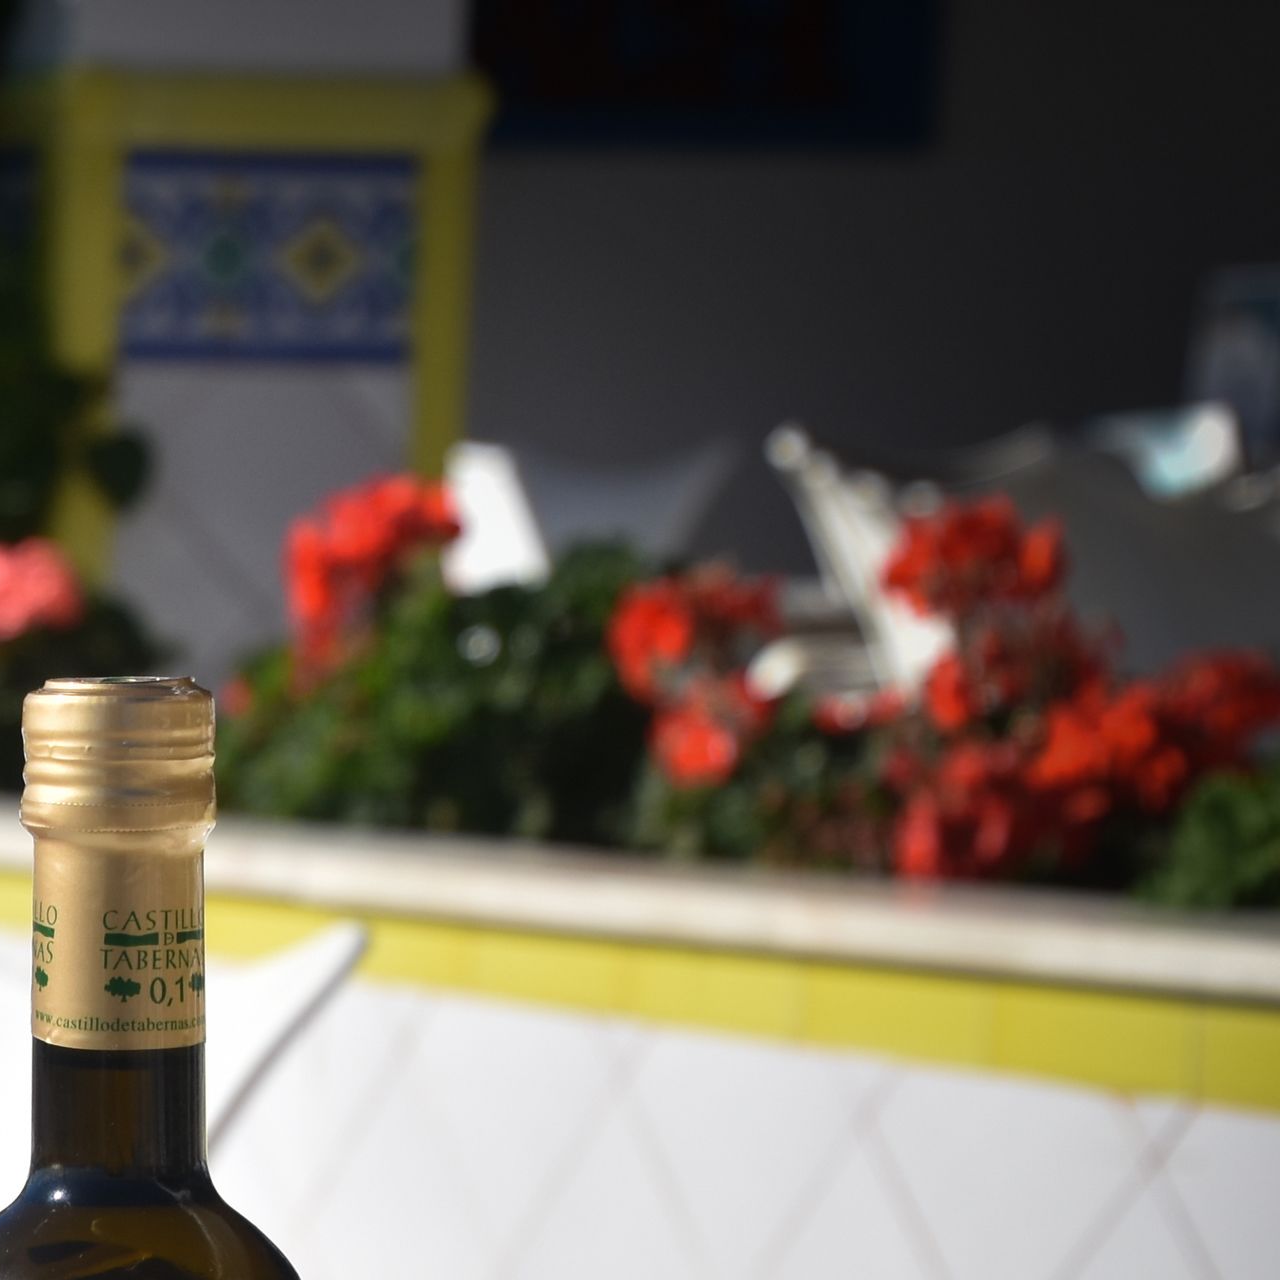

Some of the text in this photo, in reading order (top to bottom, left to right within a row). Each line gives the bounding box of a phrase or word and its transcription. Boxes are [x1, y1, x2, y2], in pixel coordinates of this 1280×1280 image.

[99, 947, 205, 970] TABERNA
[149, 976, 186, 1007] 0,1
[35, 1008, 206, 1033] www.castillodetabernas.co
